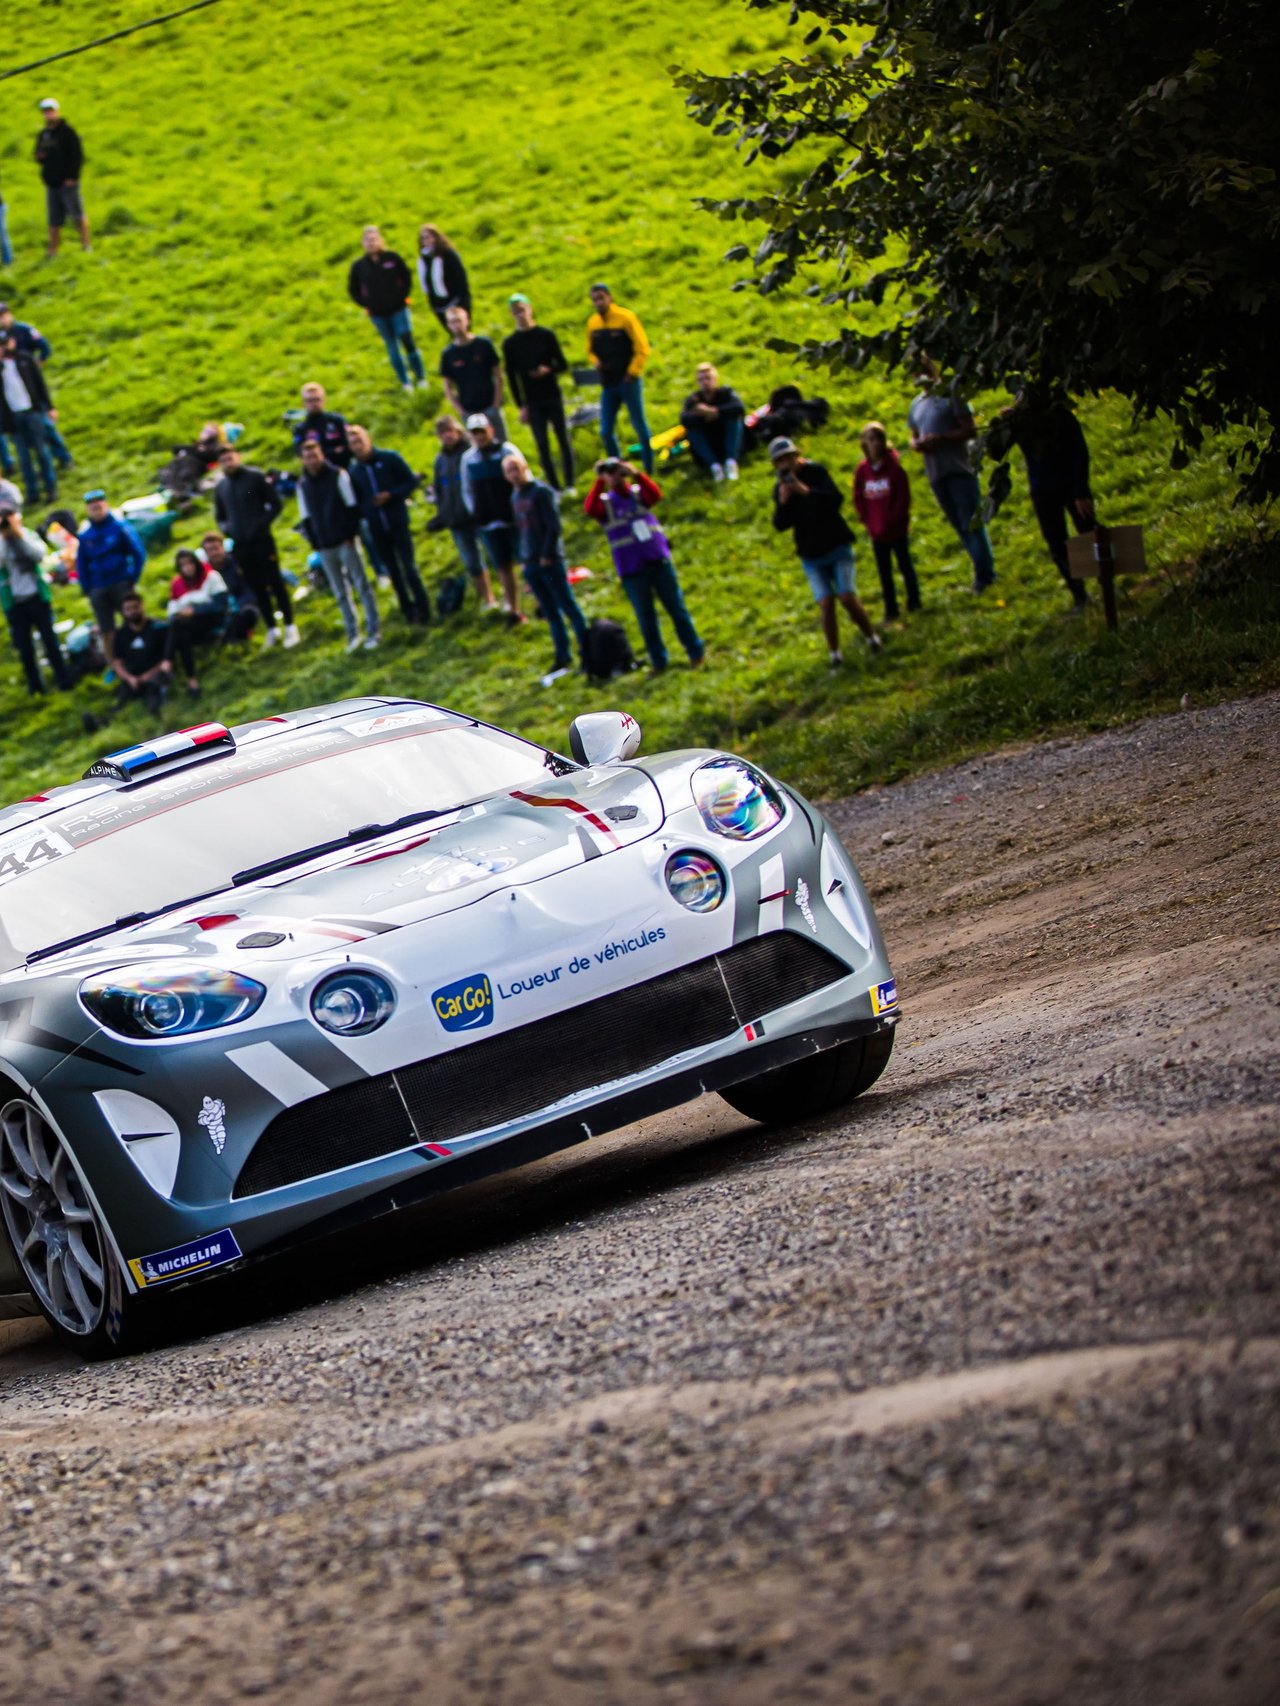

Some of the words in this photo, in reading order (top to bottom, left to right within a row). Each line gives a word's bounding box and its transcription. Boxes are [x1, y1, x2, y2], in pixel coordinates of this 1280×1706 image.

[90, 765, 117, 777] ALPINE
[59, 803, 119, 832] RS
[497, 966, 563, 1000] Loueur
[568, 957, 591, 975] de
[593, 927, 667, 964] véhicules
[157, 1243, 222, 1273] MICHELIN
